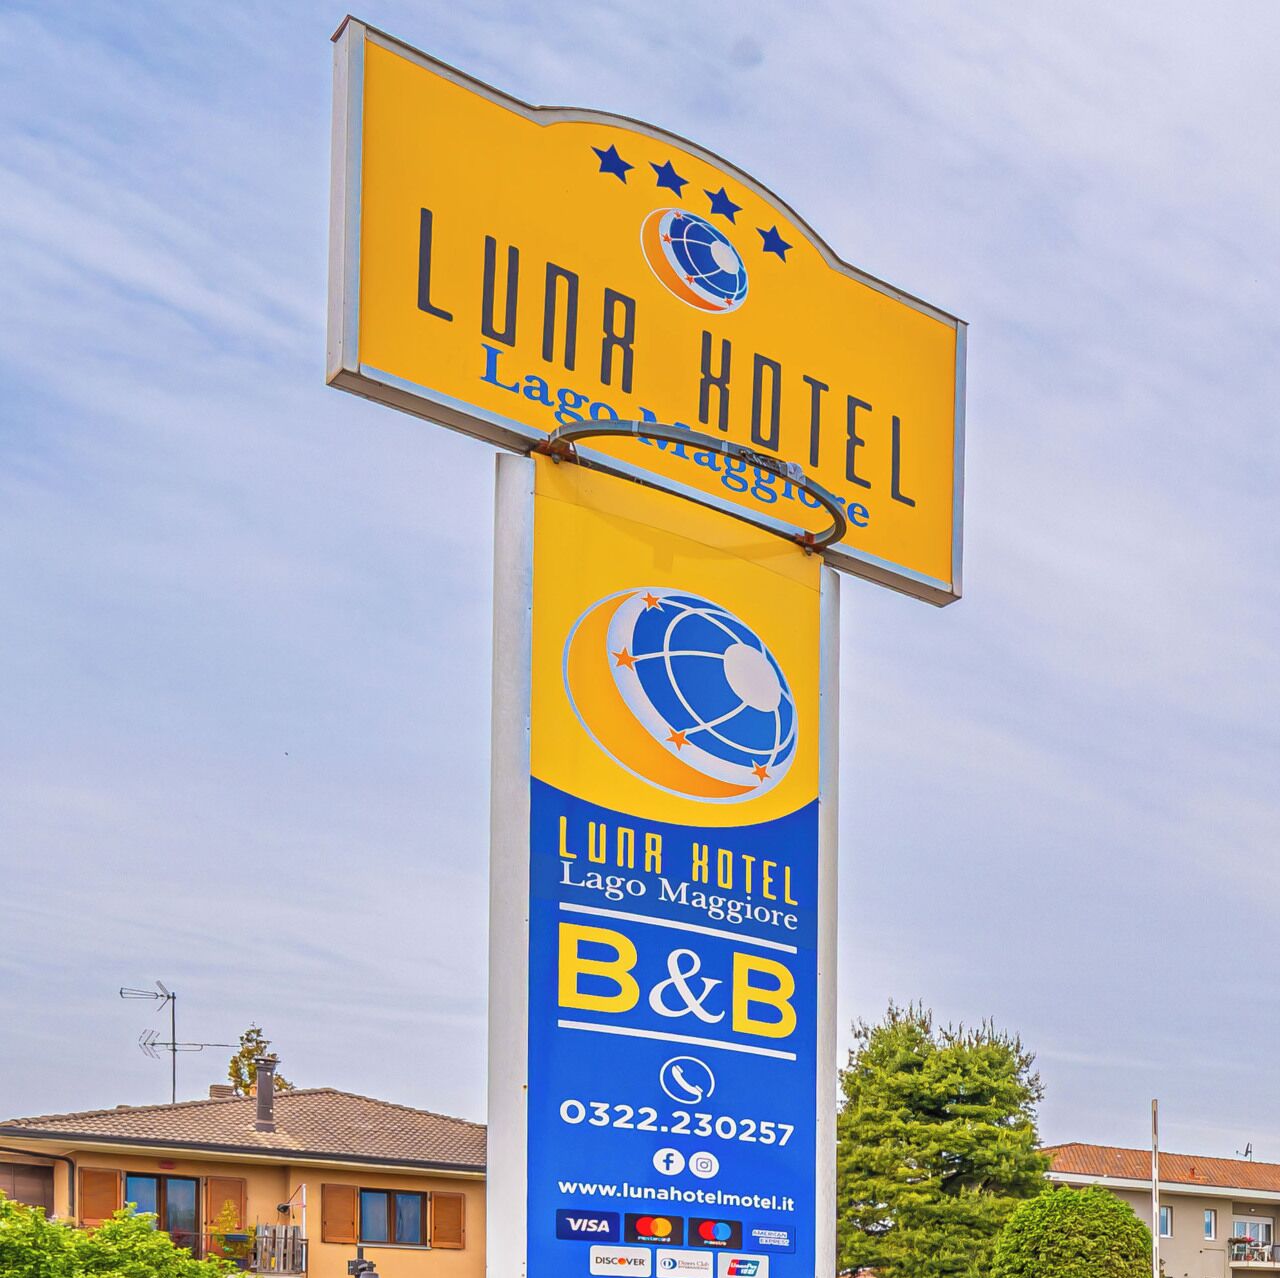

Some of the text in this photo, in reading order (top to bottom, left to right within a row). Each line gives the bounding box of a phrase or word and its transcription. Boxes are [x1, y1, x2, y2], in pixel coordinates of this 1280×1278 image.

[480, 343, 619, 427] Lago
[559, 860, 798, 930] Lago Maggiore
[558, 922, 797, 1039] B&B
[559, 1099, 795, 1146] 0322.230257
[558, 1180, 795, 1211] www.lunahotelmotel.it
[565, 1217, 610, 1233] VISA
[595, 1256, 645, 1266] DISCOVER
